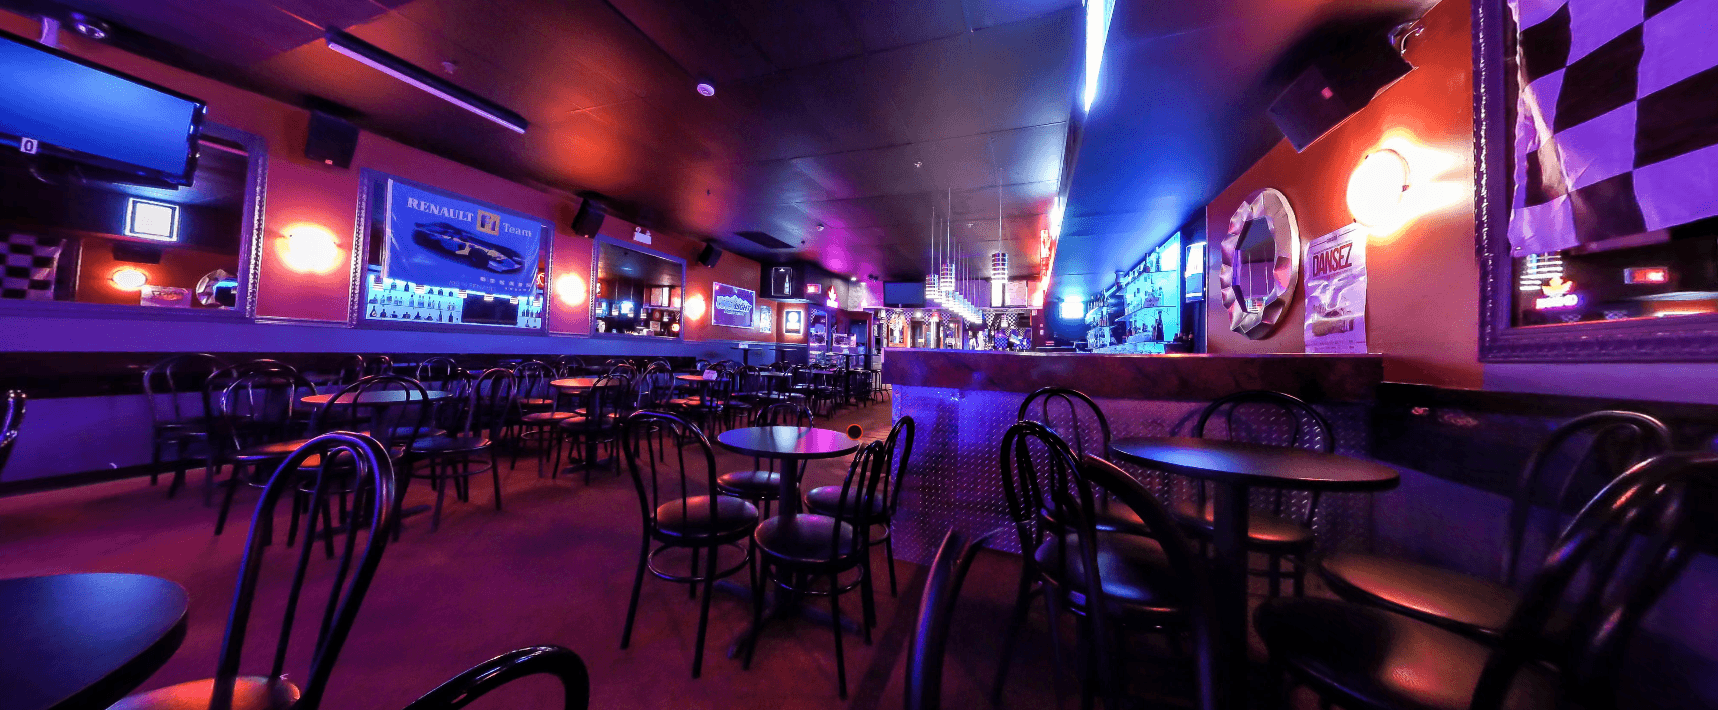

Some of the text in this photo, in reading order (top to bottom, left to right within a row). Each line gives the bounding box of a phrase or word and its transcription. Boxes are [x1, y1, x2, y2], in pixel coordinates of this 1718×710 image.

[407, 197, 532, 238] RENAULT F1 Team
[1312, 242, 1353, 278] DANSEZ
